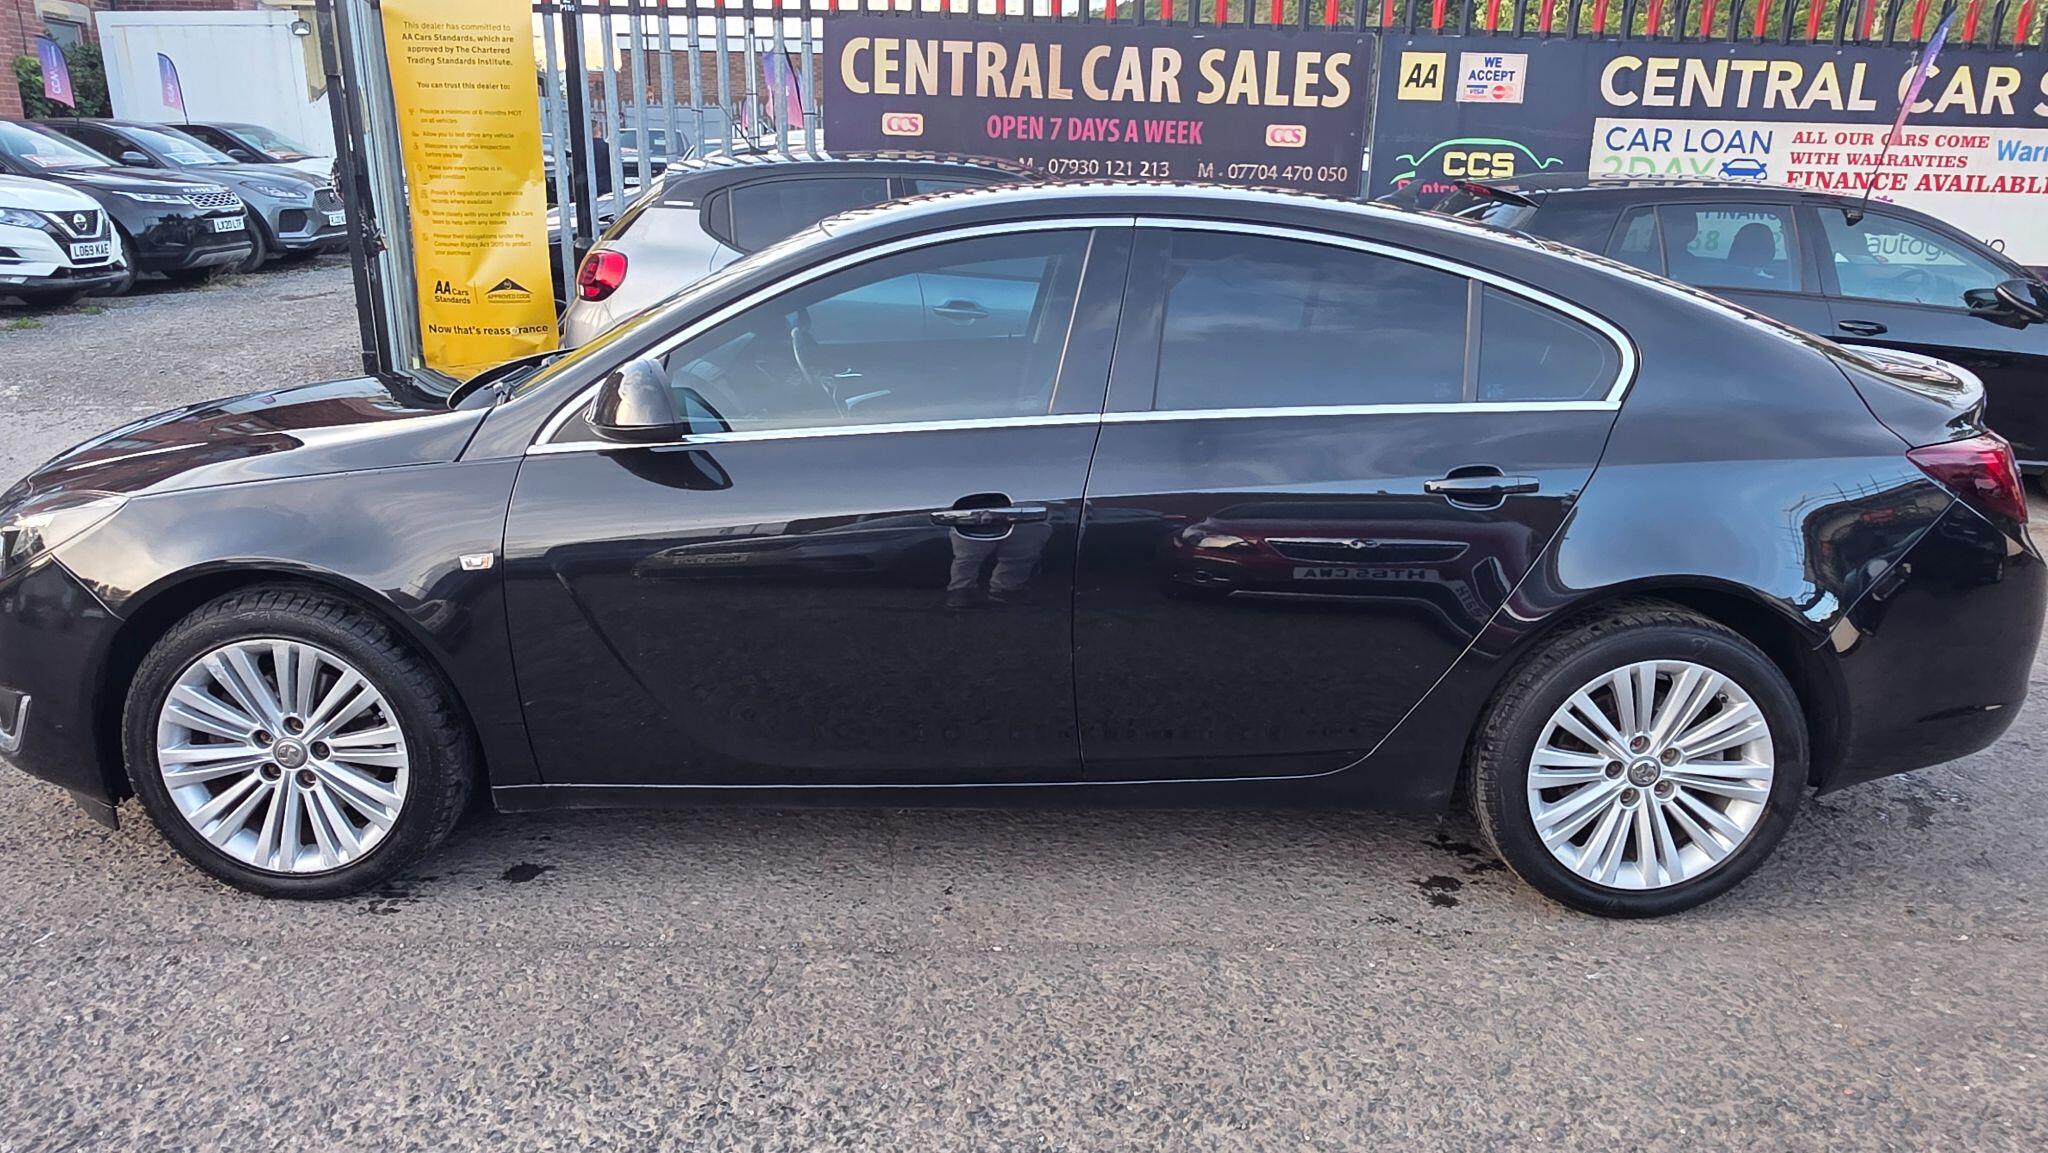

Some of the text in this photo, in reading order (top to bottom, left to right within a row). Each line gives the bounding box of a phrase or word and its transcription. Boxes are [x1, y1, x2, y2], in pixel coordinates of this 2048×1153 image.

[403, 21, 419, 29] This
[421, 22, 444, 30] dealer
[461, 23, 502, 31] committed
[414, 33, 432, 41] Cars
[407, 46, 443, 54] approved
[445, 46, 454, 54] by
[407, 57, 435, 65] Trading
[437, 57, 476, 65] Standards
[1485, 56, 1503, 68] WE
[840, 37, 1352, 109] CENTRAL CAR SALES
[1404, 63, 1438, 89] AA
[1467, 69, 1516, 82] ACCEPT
[476, 82, 498, 90] dealer
[1600, 55, 1878, 112] CENTRAL
[1898, 64, 2022, 116] CAR
[986, 115, 1204, 145] OPEN 7 DAYS A WEEK
[1605, 126, 1774, 155] CAR LOAN
[1791, 131, 1827, 145] ALL
[1833, 133, 1874, 146] OUR
[1934, 135, 1990, 149] COME
[1048, 158, 1099, 175] 07930
[1105, 160, 1133, 176] 121
[1139, 161, 1170, 177] 213
[1443, 151, 1515, 179] CCS
[1789, 151, 1969, 168] WITH WARRANTIES
[1197, 162, 1214, 178] M
[1227, 163, 1278, 180] 07704
[1281, 165, 1313, 181] 470
[1316, 166, 1348, 182] 050
[1787, 170, 2048, 193] FINANCE AVAILABL
[435, 280, 469, 297] AA Cars
[434, 295, 471, 305] Standards
[428, 324, 549, 336] Now that's reassrance
